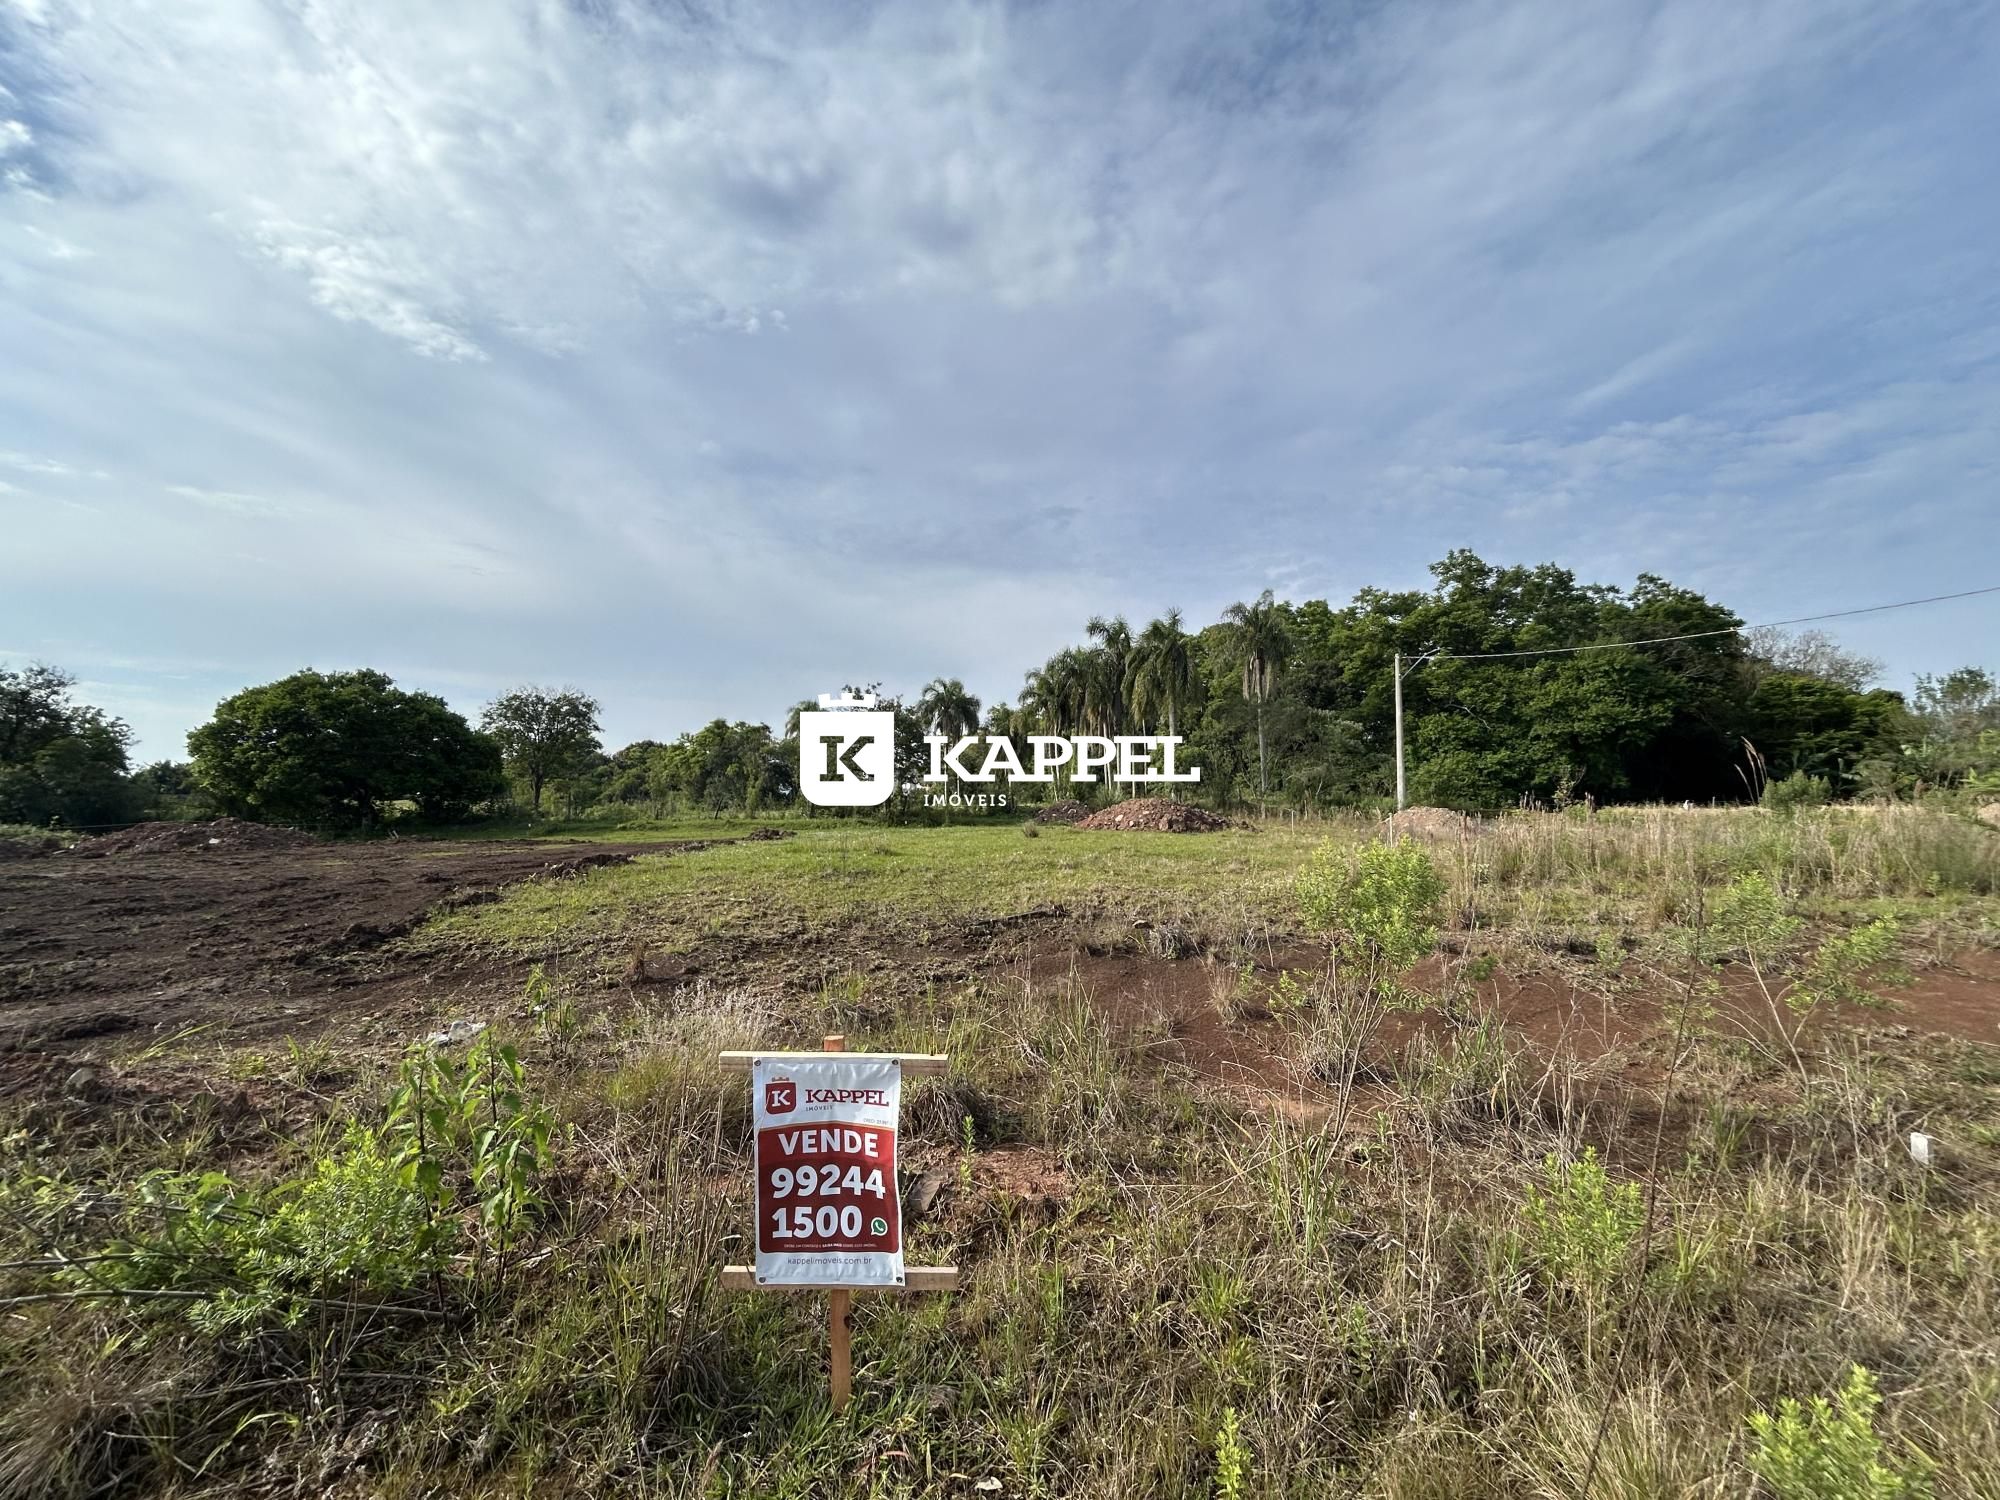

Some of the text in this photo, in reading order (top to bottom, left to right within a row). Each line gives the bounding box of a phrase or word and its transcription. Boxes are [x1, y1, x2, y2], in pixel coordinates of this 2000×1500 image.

[771, 1089, 791, 1107] K
[805, 1088, 890, 1107] KAPPEL
[778, 1128, 879, 1158] VENDE
[771, 1164, 885, 1199] 99244
[771, 1205, 862, 1238] 1500
